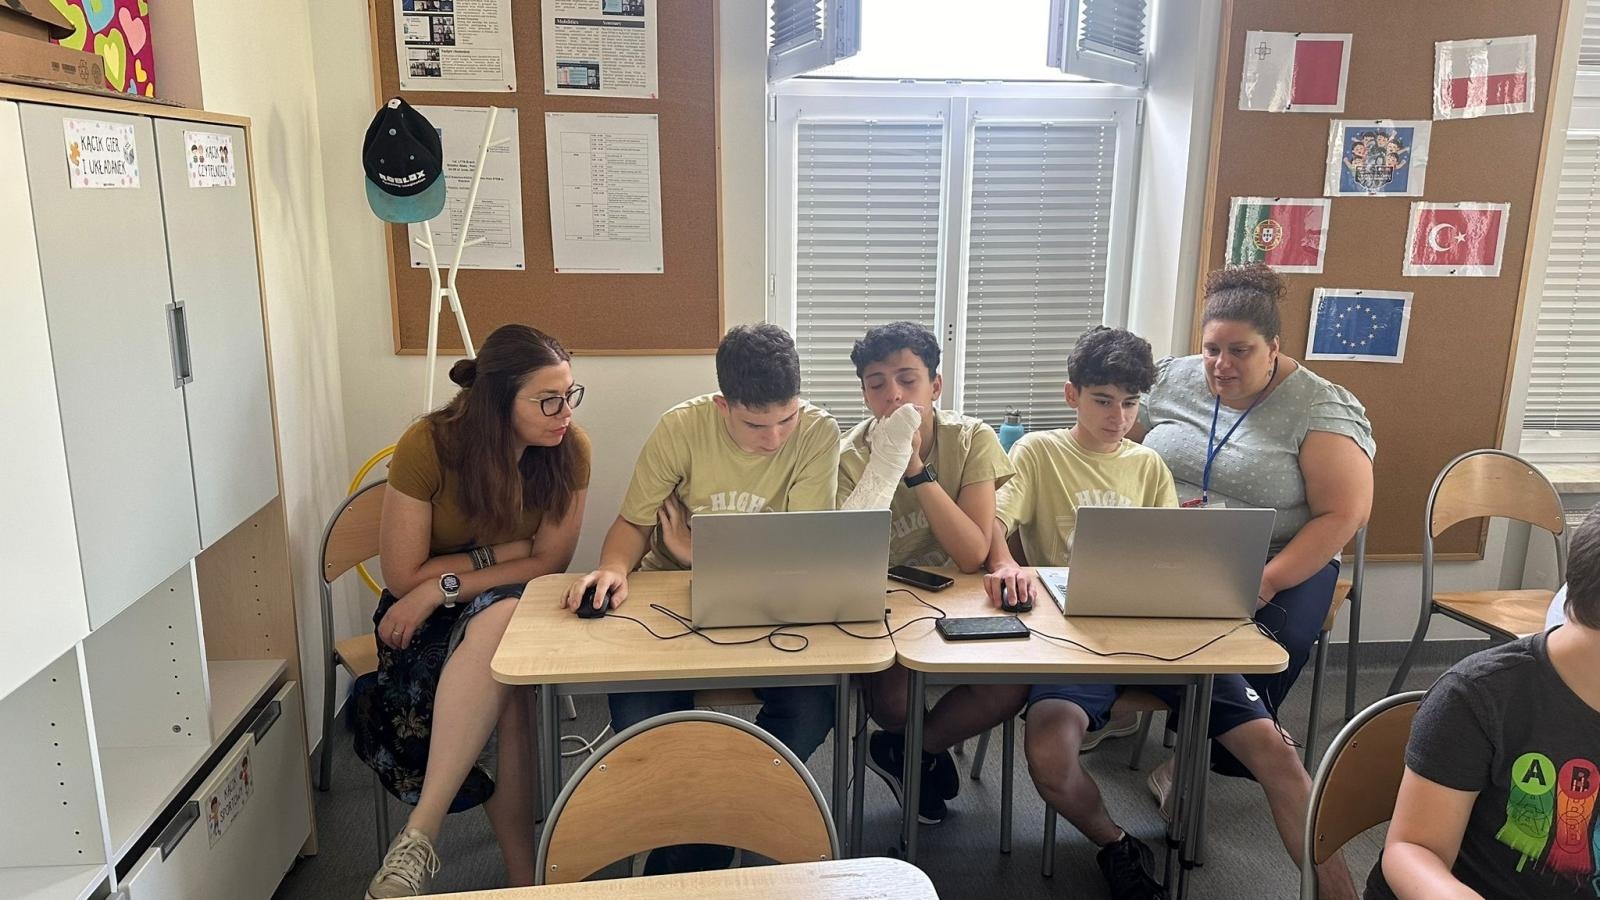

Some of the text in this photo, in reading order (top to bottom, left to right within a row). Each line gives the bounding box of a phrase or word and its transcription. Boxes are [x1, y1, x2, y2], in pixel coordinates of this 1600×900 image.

[105, 136, 121, 153] GIER
[82, 158, 127, 175] I UKŁADANEK
[378, 169, 426, 184] ROBLOX
[710, 490, 766, 513] HIGH
[1521, 758, 1547, 786] A
